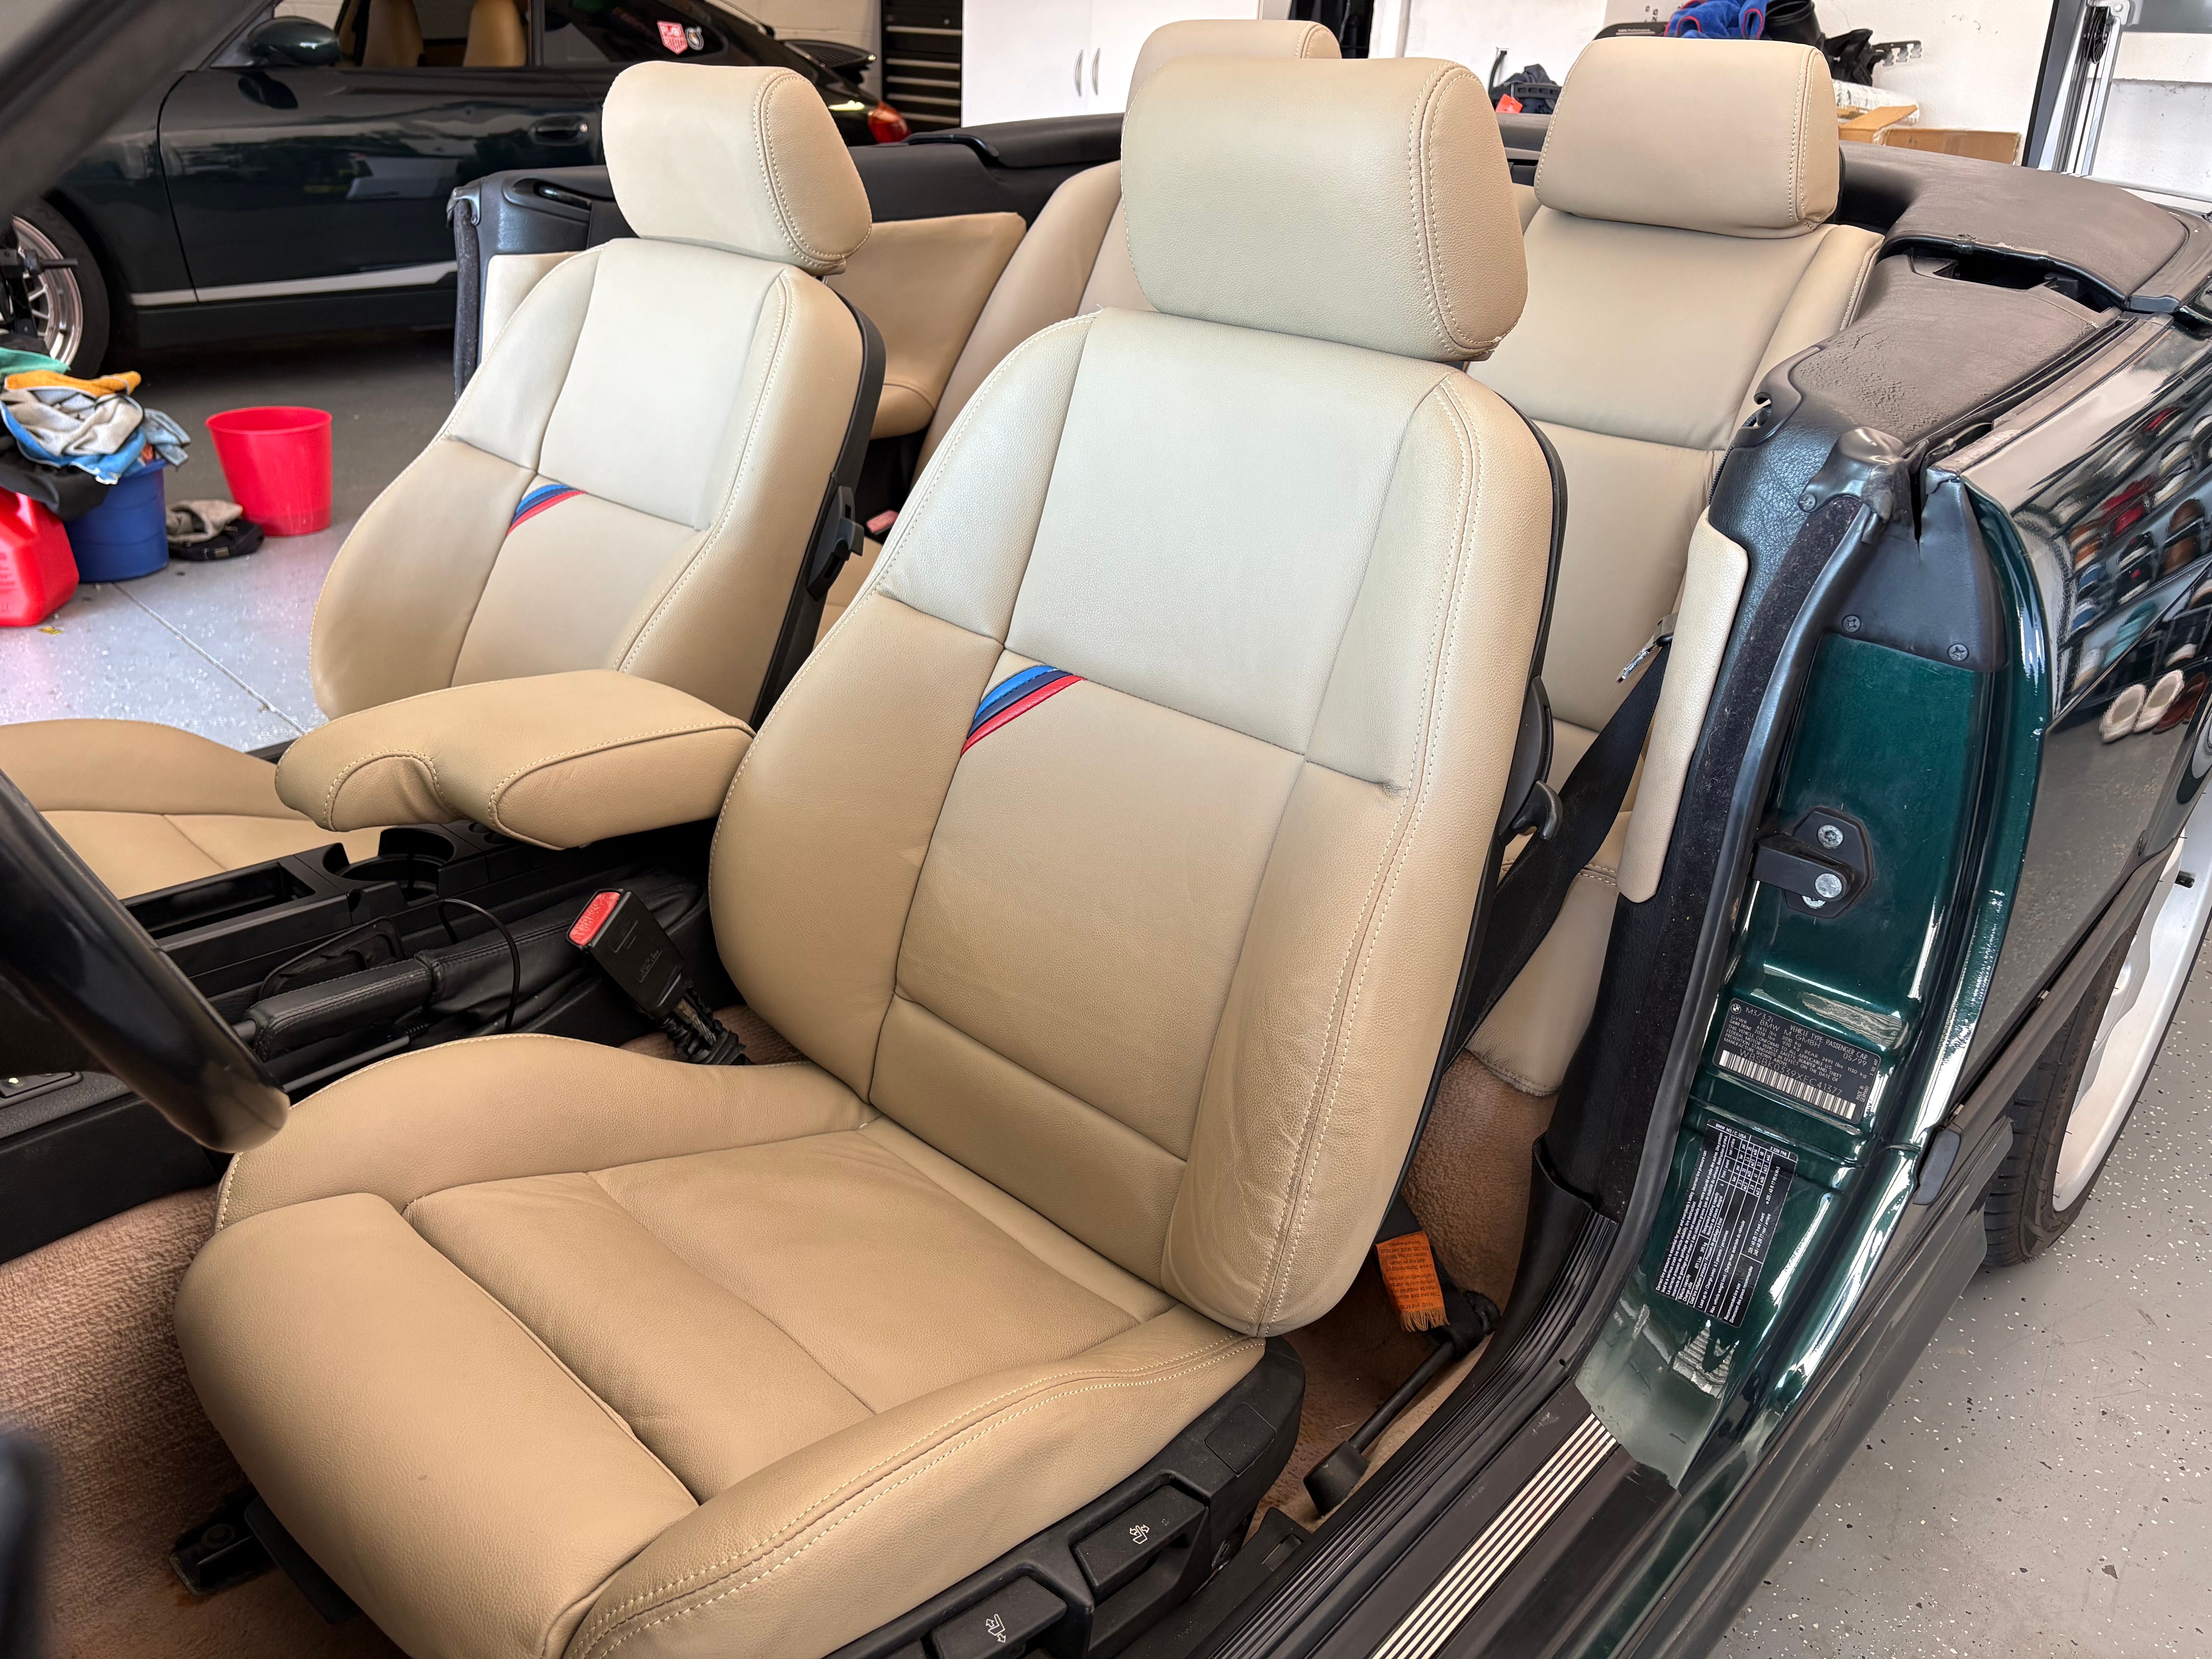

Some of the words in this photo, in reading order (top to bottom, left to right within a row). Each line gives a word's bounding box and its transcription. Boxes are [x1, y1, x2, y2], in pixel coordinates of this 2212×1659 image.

[1731, 1015, 1747, 1024] GVWR
[1745, 1007, 1773, 1023] M3/3.2i
[1739, 1028, 1755, 1038] VEHICLE
[1756, 1036, 1780, 1048] CONFORMS
[1760, 1019, 1780, 1031] BMW
[1795, 1034, 1820, 1048] GMBH
[1790, 1025, 1809, 1037] VEHICLE
[1811, 1033, 1824, 1043] TYPE
[1826, 1039, 1855, 1055] PASSENGER
[1856, 1051, 1868, 1060] CAR
[1724, 1037, 1754, 1053] MANUFACTURE
[1756, 1050, 1772, 1060] SHOWN
[1725, 1032, 1750, 1046] PREVENTION
[1751, 1043, 1776, 1057] STANDARDS
[1783, 1057, 1799, 1066] EFFECT
[1819, 1071, 1831, 1079] DATE
[1726, 1028, 1743, 1039] FEDERAL
[1745, 1036, 1761, 1046] MOTOR
[1762, 1043, 1779, 1053] VEHICLE
[1798, 1058, 1816, 1068] BUMPER
[1829, 1070, 1842, 1079] THEFT
[1754, 1029, 1765, 1037] 2028
[1804, 1049, 1819, 1058] REAR
[1822, 1056, 1833, 1065] 2491
[1843, 1053, 1867, 1066] 05/99
[1740, 1048, 1843, 1096] WBSBK0339XEC41377
[1860, 1085, 1869, 1103] GERMANY
[1705, 1246, 1713, 1261] Pression
[1678, 1287, 1686, 1299] Vehicle
[1683, 1274, 1692, 1288] capacity
[1729, 1305, 1739, 1323] Dimension
